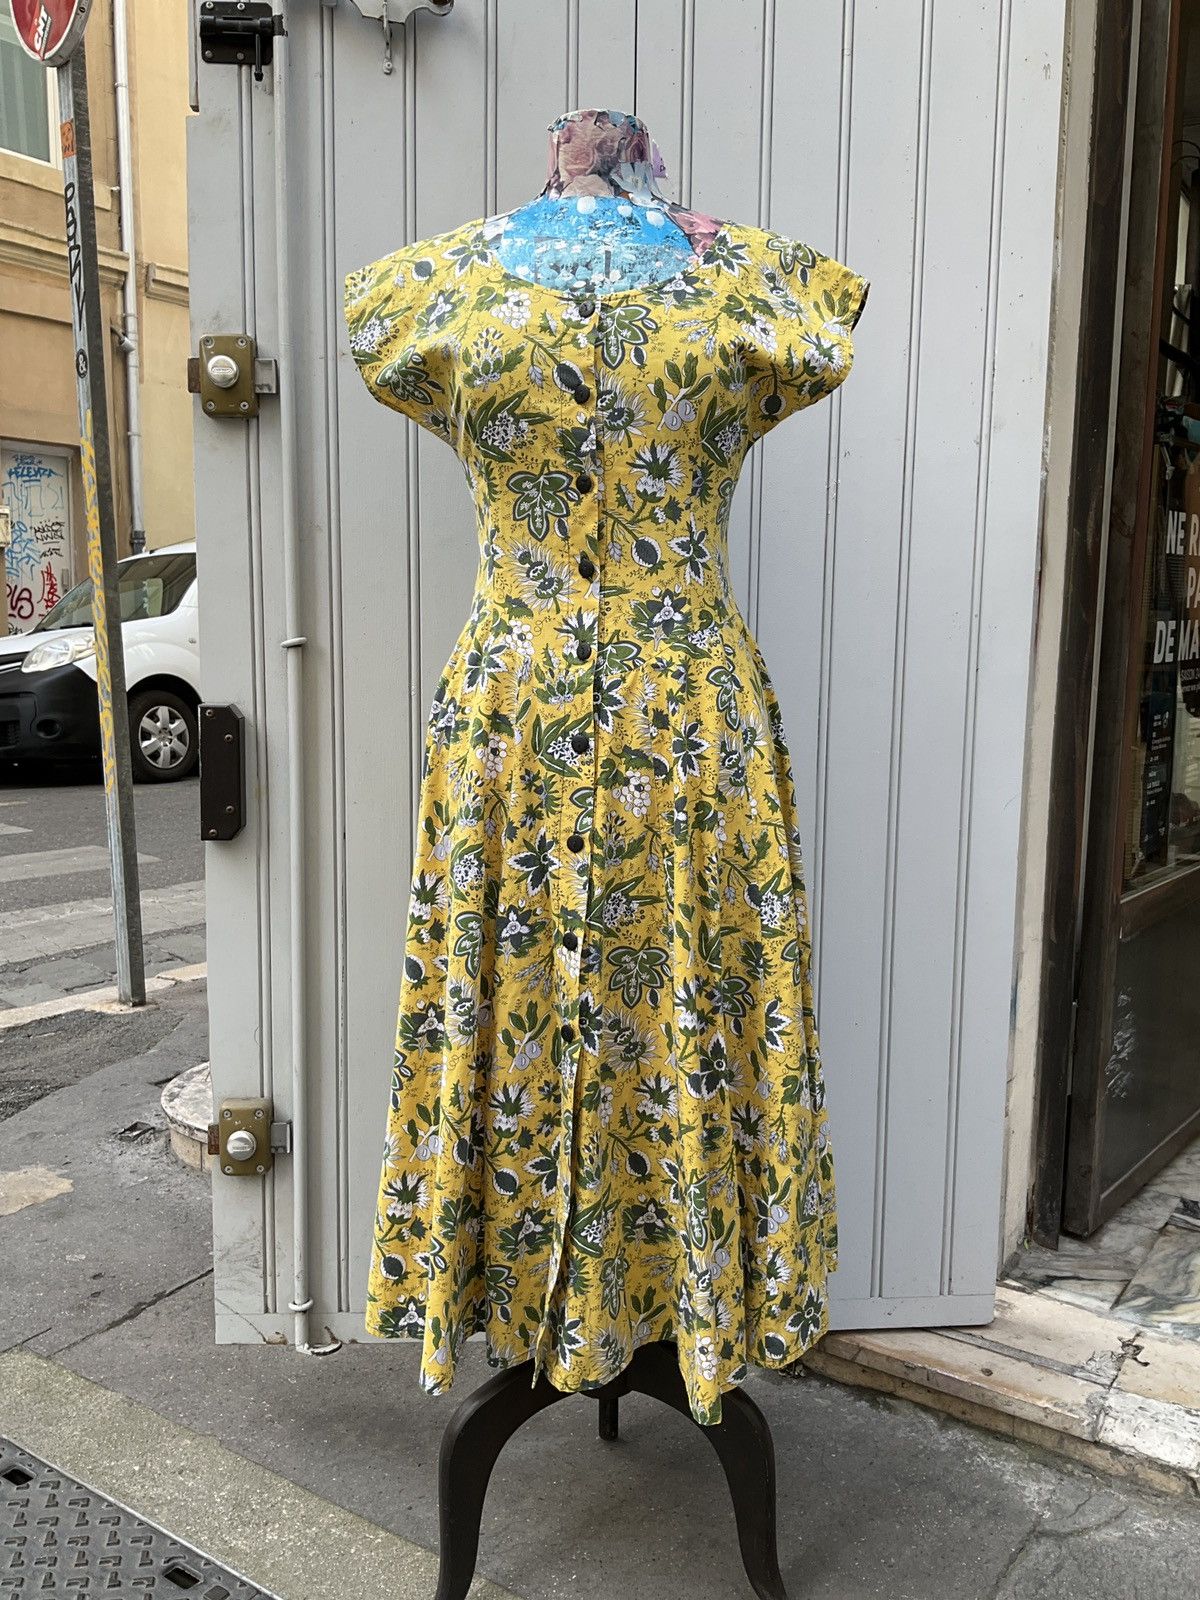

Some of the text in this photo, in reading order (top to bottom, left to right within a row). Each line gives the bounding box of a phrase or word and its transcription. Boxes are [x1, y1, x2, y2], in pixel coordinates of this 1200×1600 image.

[1166, 510, 1200, 556] NE R
[1153, 620, 1200, 664] DE MA
